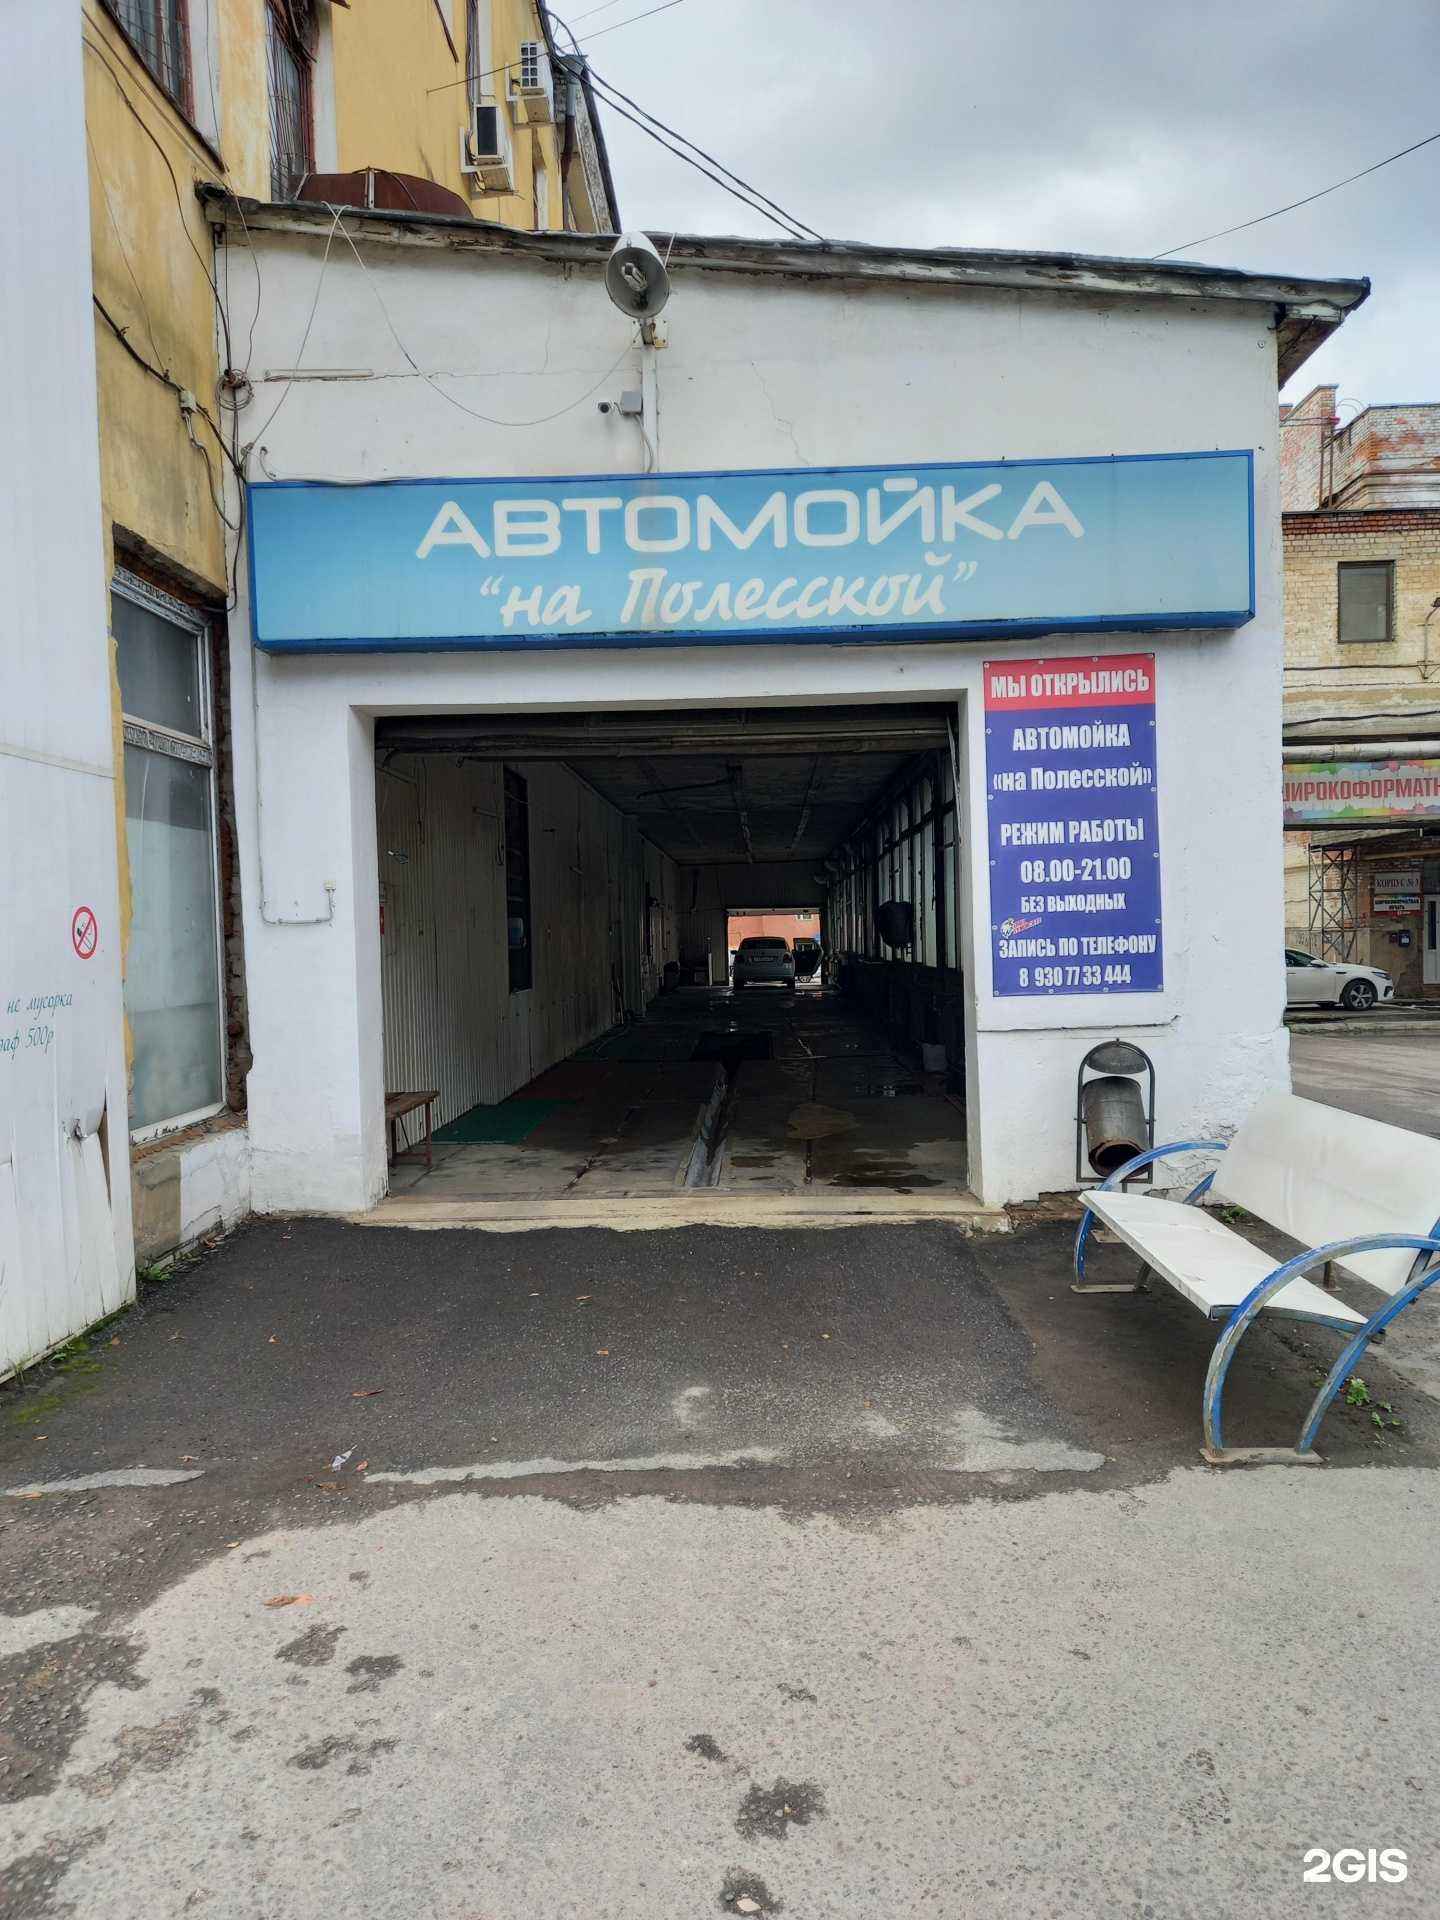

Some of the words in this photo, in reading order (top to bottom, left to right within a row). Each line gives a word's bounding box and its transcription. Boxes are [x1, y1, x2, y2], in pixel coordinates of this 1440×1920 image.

[415, 478, 1085, 560] АВТОМОЙКА
[991, 674, 1027, 698] МЫ
[1030, 668, 1150, 697] ОТКРЫЛИСЬ
[1012, 720, 1131, 751] АВТОМОЙКА
[1000, 821, 1065, 846] РЕЖИМ
[1068, 818, 1144, 844] РАБОТЫ
[1020, 857, 1132, 883] 08.00-21.00
[1021, 895, 1046, 913] БЕЗ
[1047, 892, 1127, 914] ВЫХОДНЫХ
[998, 937, 1056, 959] ЗАПИСЬ
[1058, 936, 1078, 957] ПО
[1080, 934, 1157, 957] ТЕЛЕФОНУ
[1019, 967, 1029, 987] 8
[1034, 966, 1063, 987] 930
[1104, 964, 1132, 985] 444
